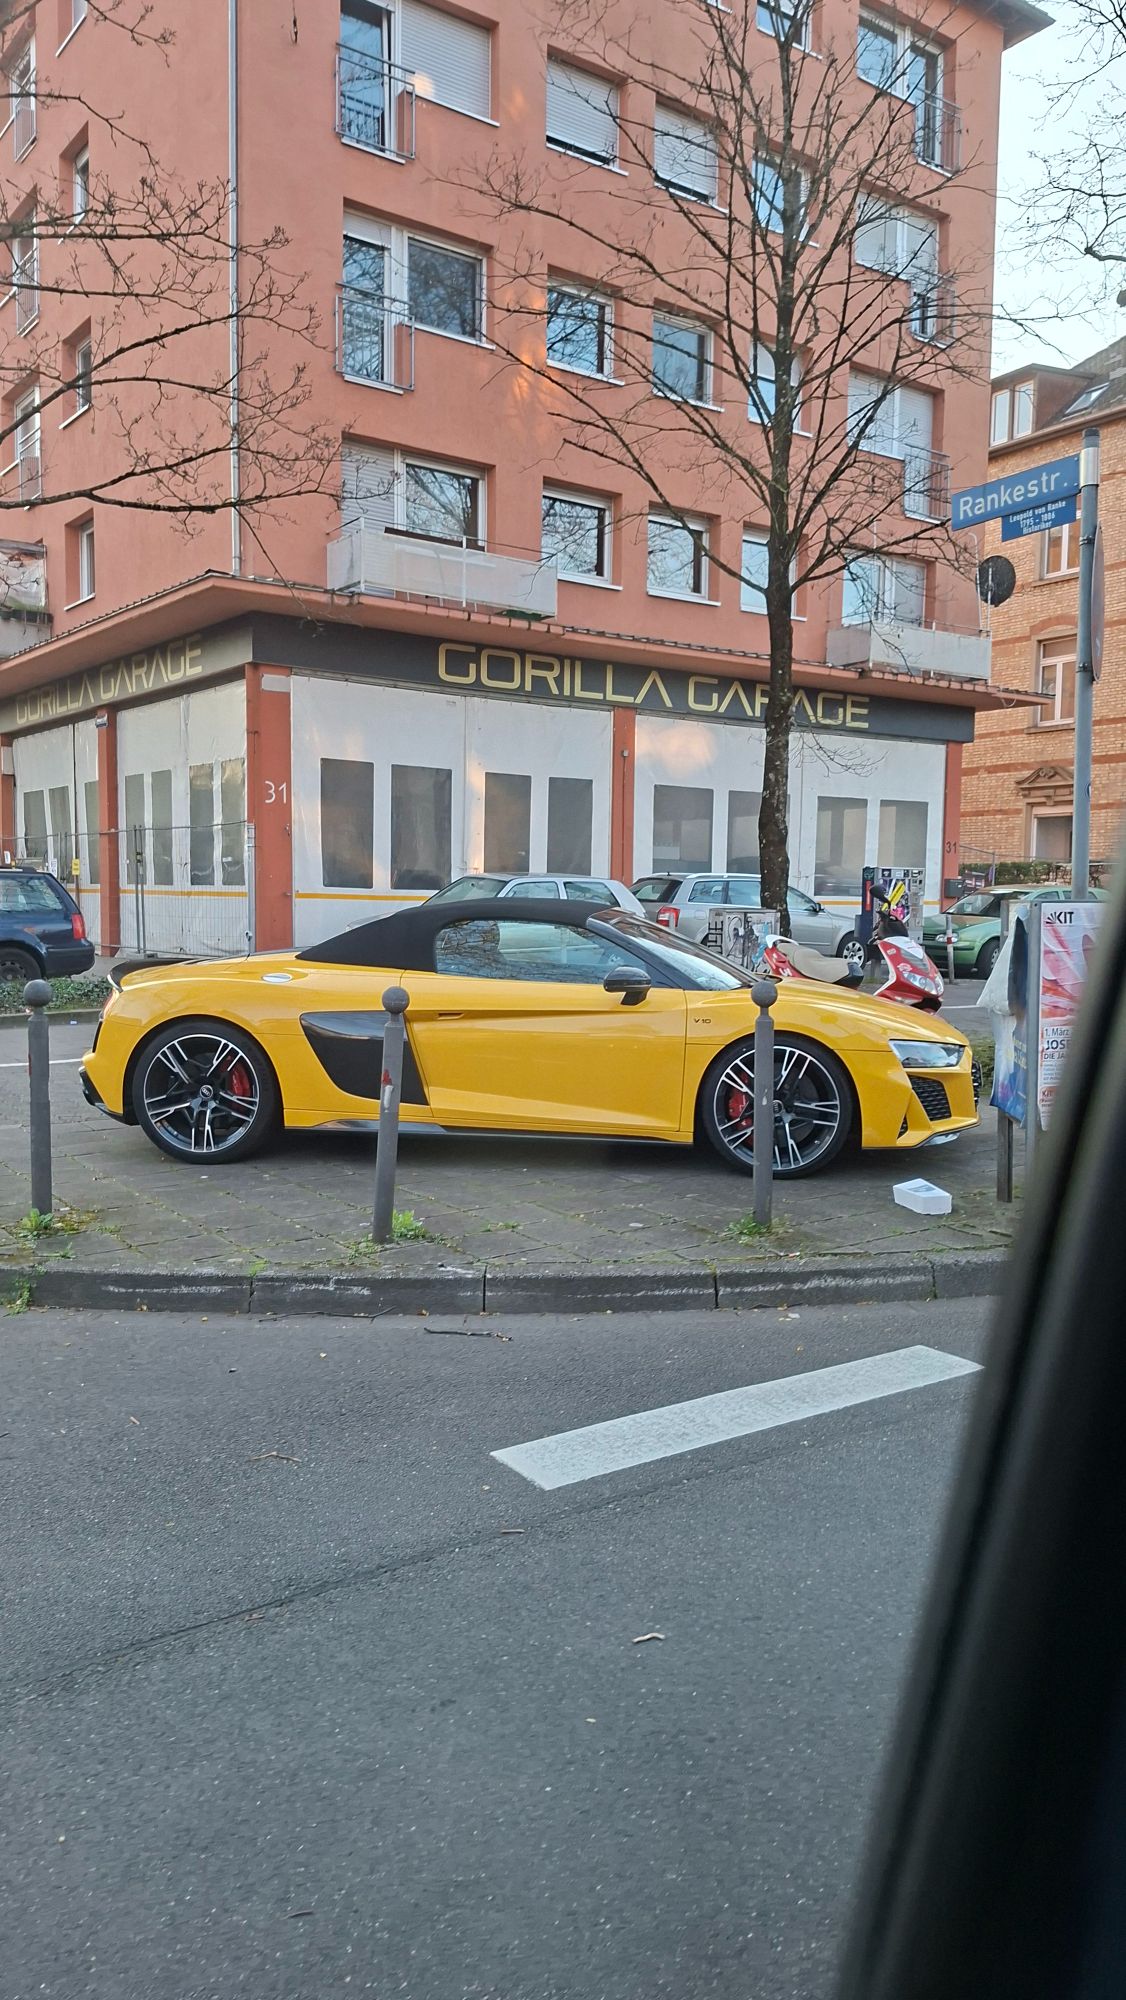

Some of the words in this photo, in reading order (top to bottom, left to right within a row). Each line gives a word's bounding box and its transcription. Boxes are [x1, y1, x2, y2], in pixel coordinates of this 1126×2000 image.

[959, 471, 1068, 520] Rankestr.
[1009, 509, 1033, 523] Leopold
[1034, 507, 1046, 515] von
[1047, 501, 1067, 511] Ranke
[1020, 517, 1034, 528] 1795
[1022, 521, 1053, 535] Historiker
[15, 672, 95, 726] GORILLA
[100, 634, 203, 700] GARAGE
[438, 642, 673, 709] GORILLA
[264, 780, 287, 804] 31
[945, 841, 957, 854] 31
[1056, 911, 1075, 924] KIT
